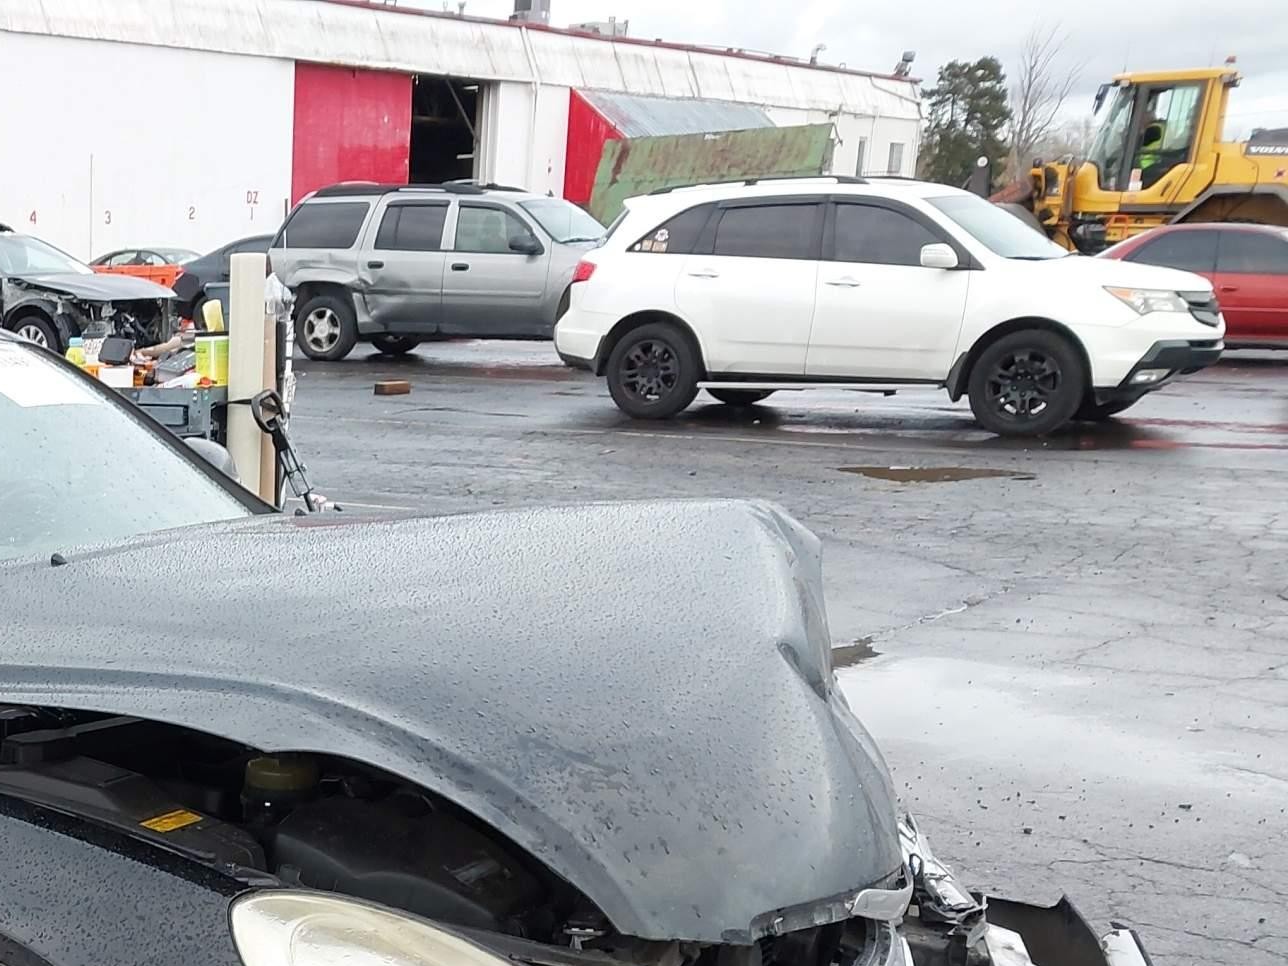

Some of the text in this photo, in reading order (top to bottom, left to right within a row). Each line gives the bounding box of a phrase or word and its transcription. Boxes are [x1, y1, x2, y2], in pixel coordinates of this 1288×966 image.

[246, 191, 259, 204] DZ
[29, 210, 37, 225] 4
[104, 210, 112, 225] 3
[188, 206, 195, 220] 2
